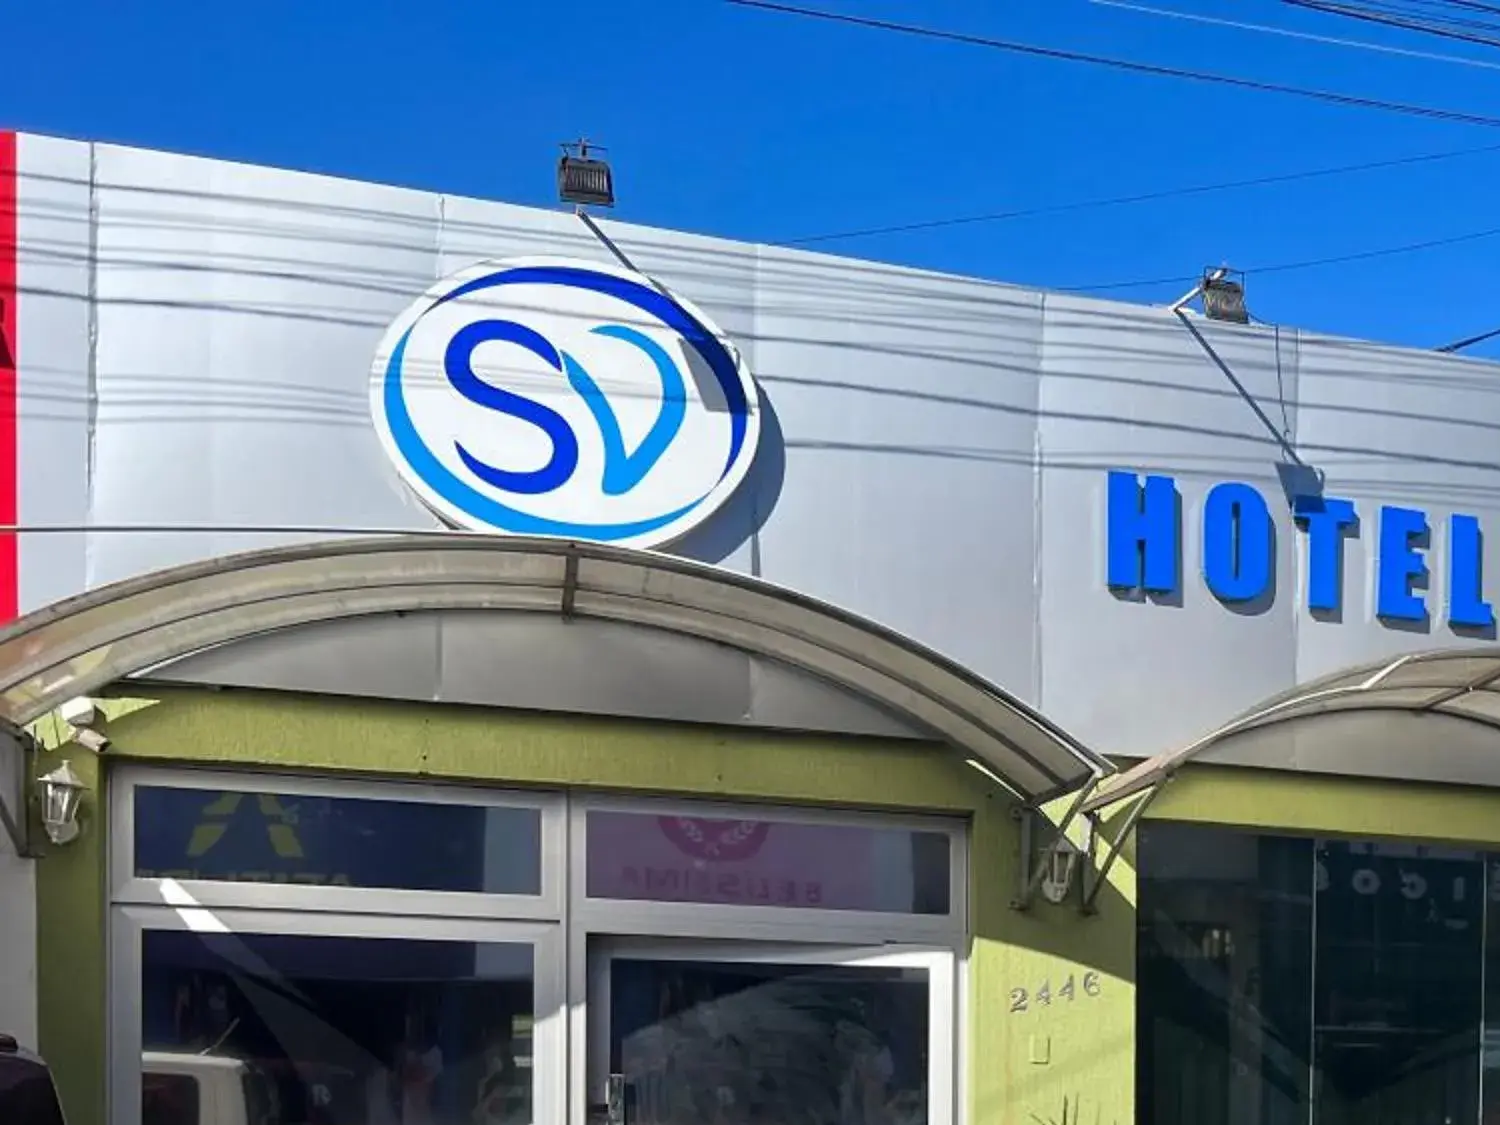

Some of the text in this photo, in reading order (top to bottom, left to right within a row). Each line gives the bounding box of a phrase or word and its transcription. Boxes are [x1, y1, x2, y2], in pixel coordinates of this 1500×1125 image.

[444, 318, 687, 496] SV
[1106, 470, 1495, 626] HOTEL
[1008, 971, 1101, 1013] 2446
